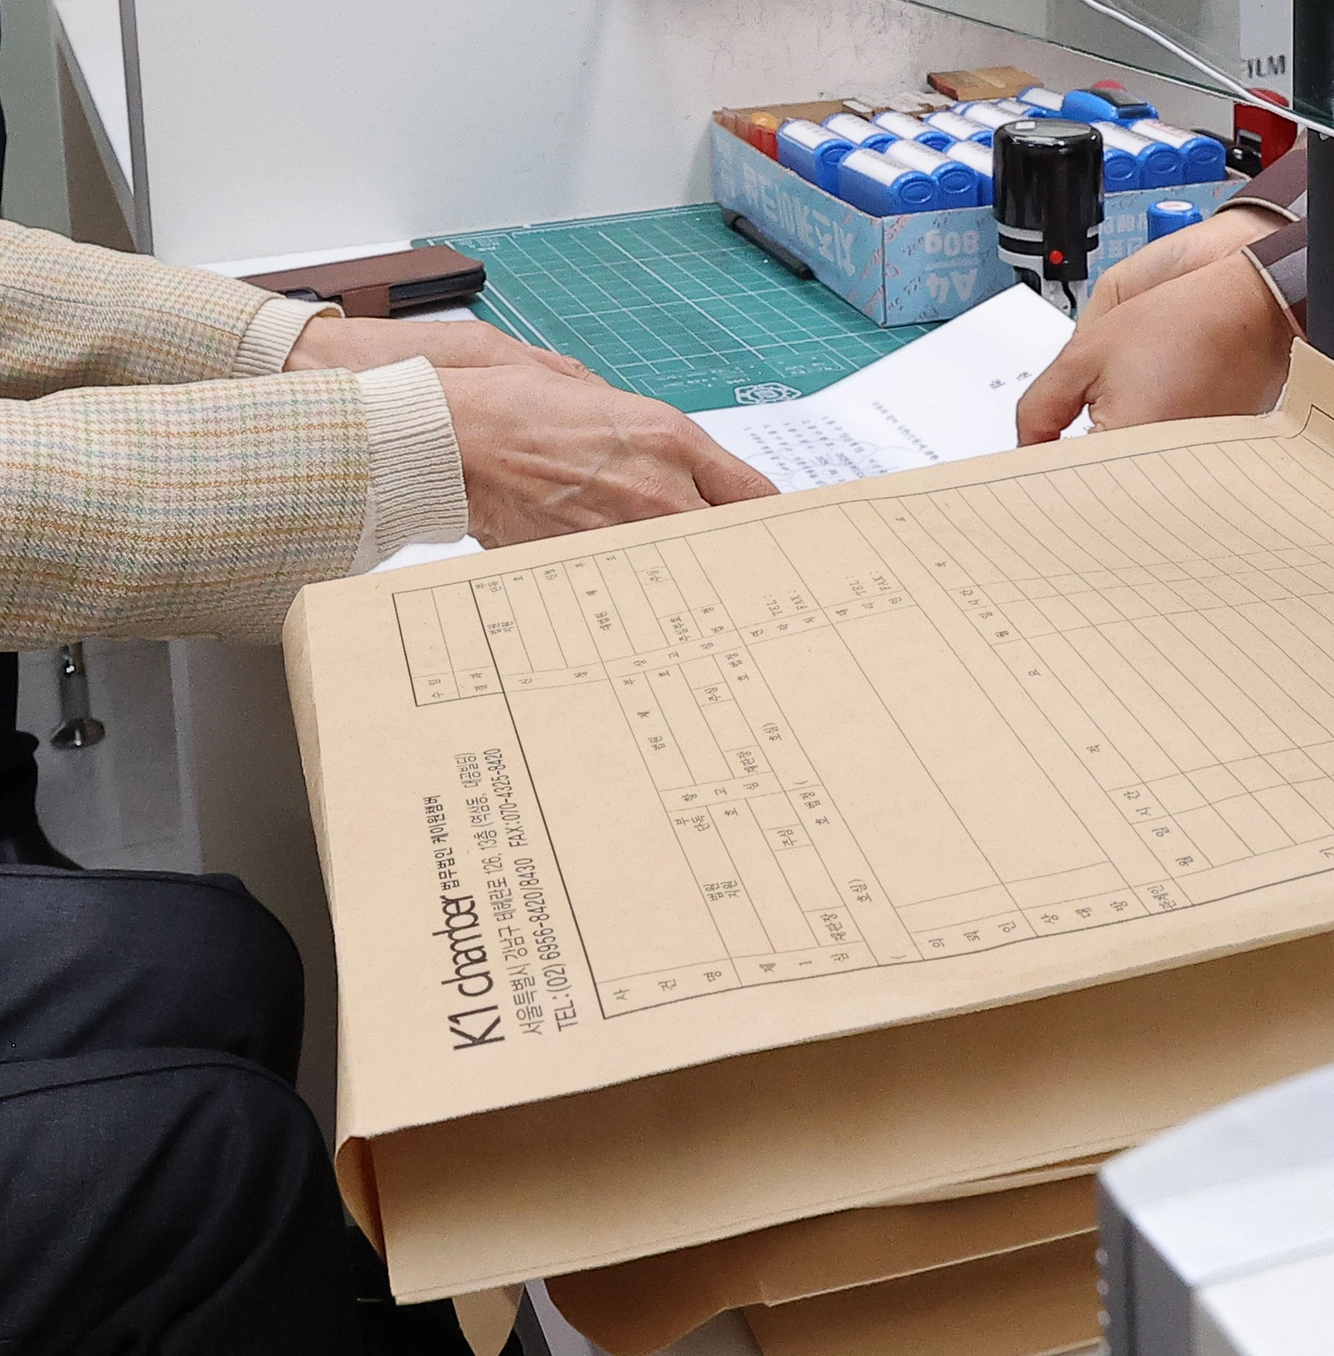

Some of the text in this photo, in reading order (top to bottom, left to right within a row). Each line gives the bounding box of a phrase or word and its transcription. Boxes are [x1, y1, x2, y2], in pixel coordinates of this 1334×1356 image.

[925, 268, 978, 304] A4
[423, 795, 460, 891] 법무법인 케이원챔버
[473, 830, 497, 850] 13층
[487, 877, 517, 922] 테헤란로
[514, 857, 561, 961] 6956-8420/8430
[498, 925, 528, 961] 강남구
[432, 895, 505, 1050] K1 chamber
[505, 963, 545, 1035] 서울특별시
